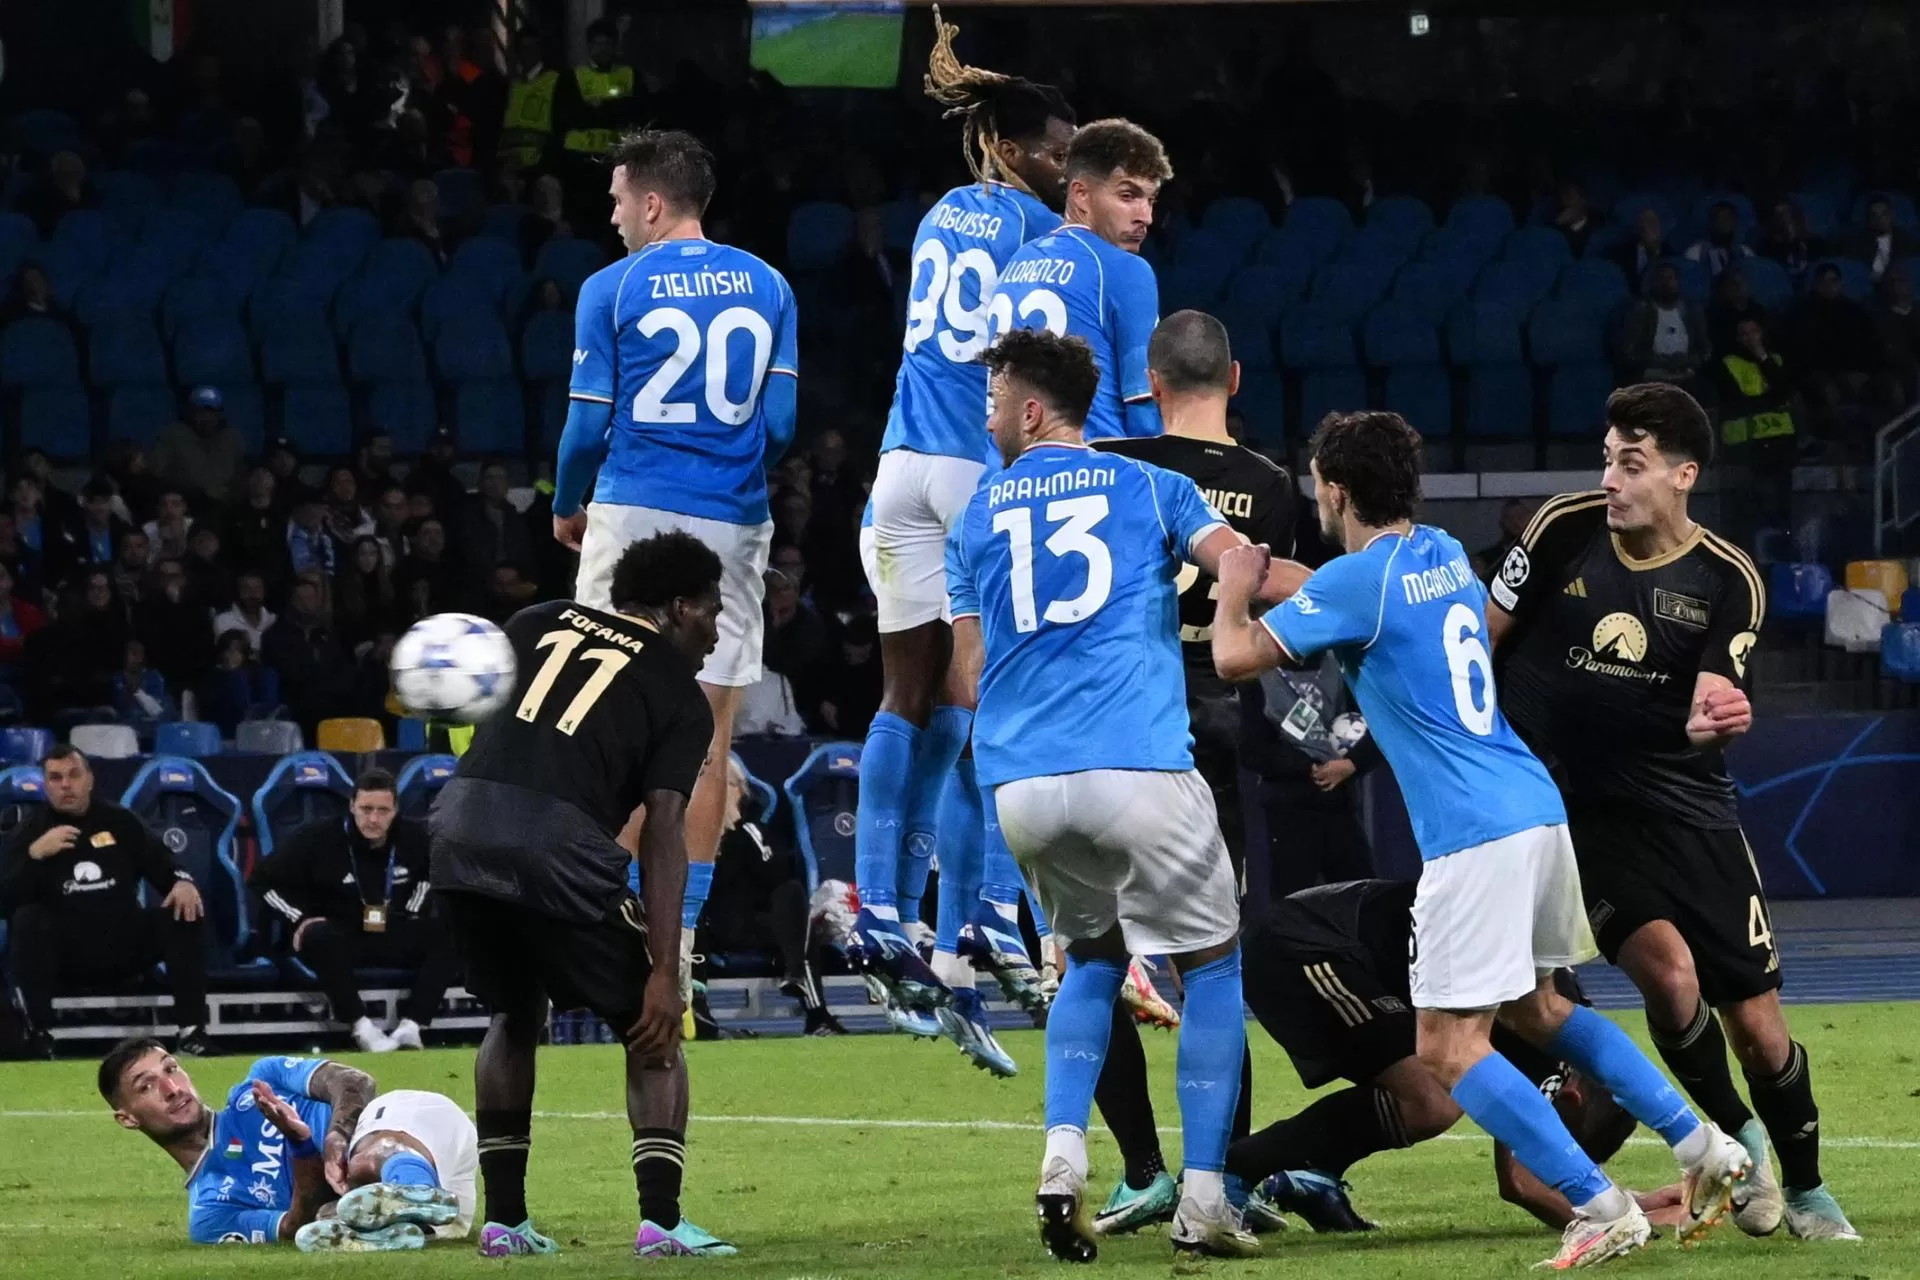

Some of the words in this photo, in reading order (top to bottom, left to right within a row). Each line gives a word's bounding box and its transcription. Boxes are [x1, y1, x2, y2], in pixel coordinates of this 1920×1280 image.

[903, 238, 998, 363] 99
[632, 306, 773, 425] 20
[988, 468, 1116, 509] RRAHMANI
[992, 494, 1113, 634] 13
[1402, 565, 1457, 605] MARIO
[515, 629, 632, 737] 11
[558, 608, 645, 654] FOFANA
[1442, 603, 1495, 736] 6
[1749, 894, 1772, 950] 4
